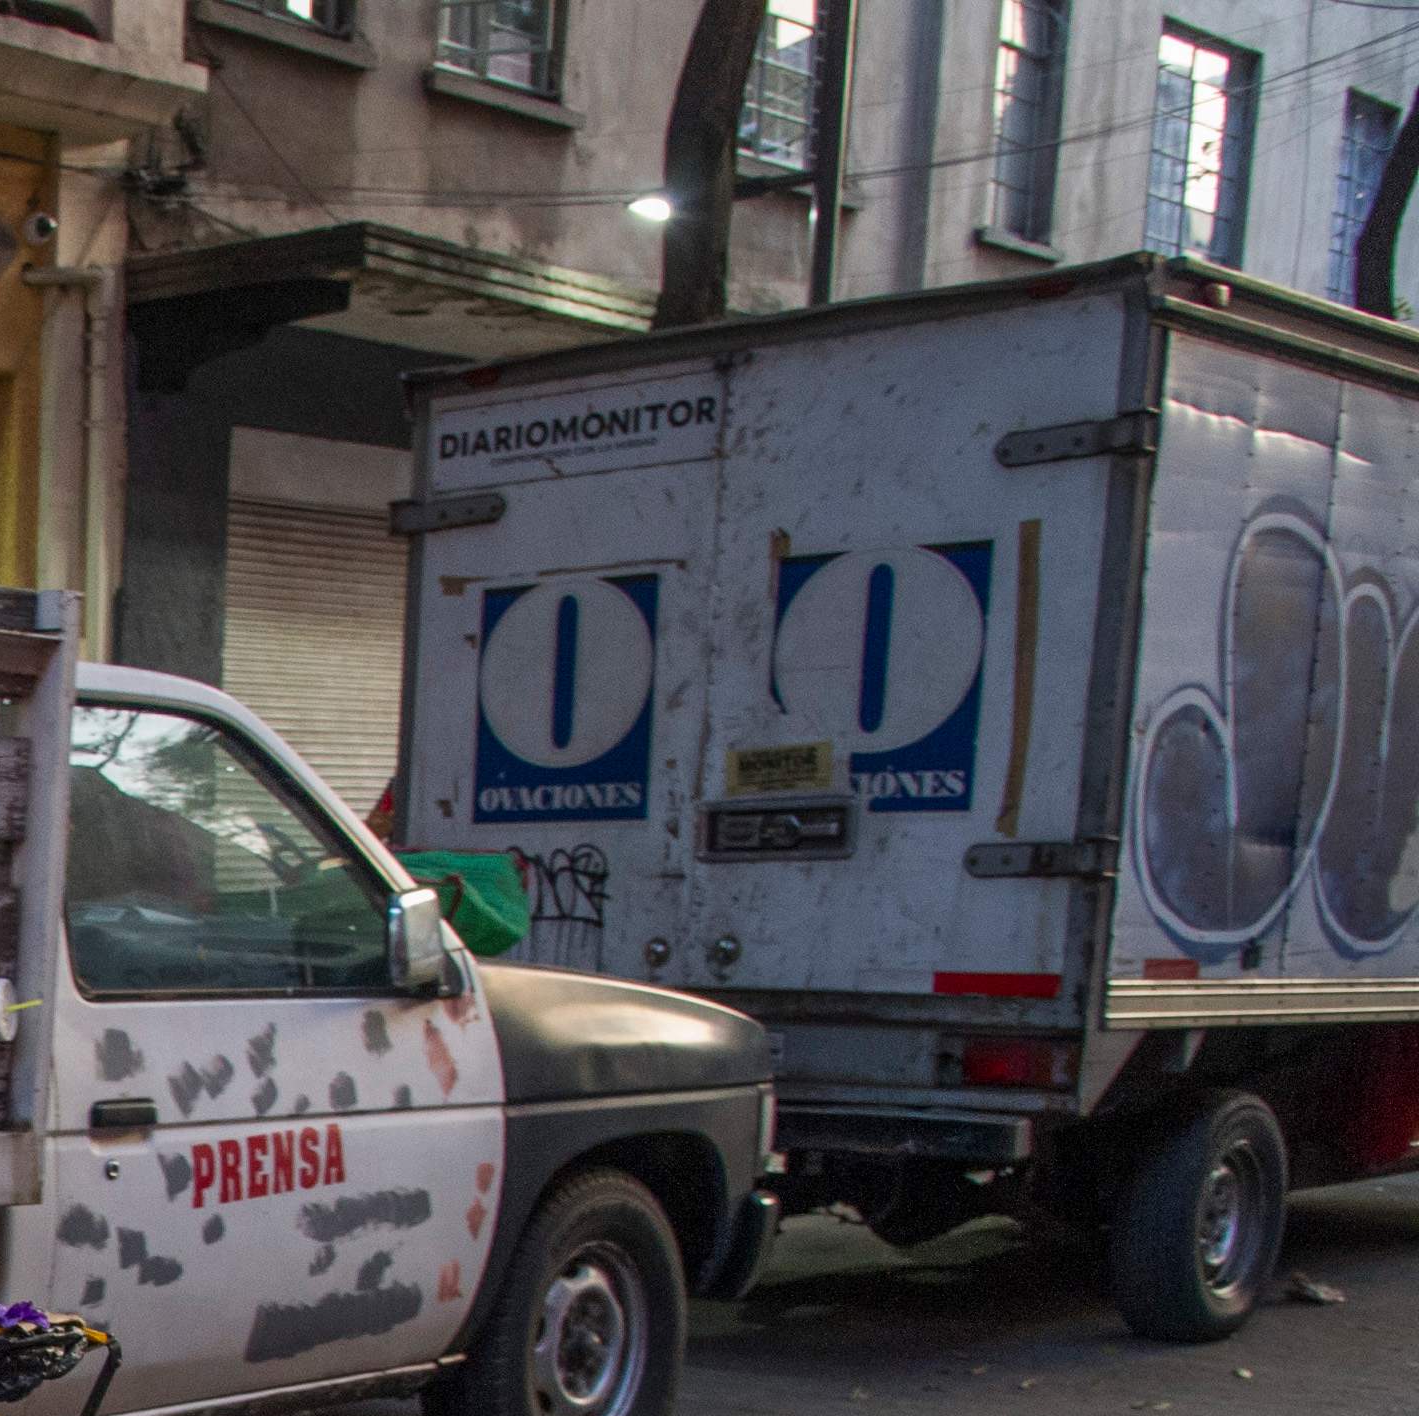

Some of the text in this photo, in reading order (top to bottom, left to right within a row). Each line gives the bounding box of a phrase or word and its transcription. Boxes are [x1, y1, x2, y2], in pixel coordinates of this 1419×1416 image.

[439, 398, 717, 459] DIARIOMONITOR
[479, 782, 643, 811] OVACIONES
[854, 769, 965, 798] IONES
[192, 1123, 345, 1209] PRENSA
